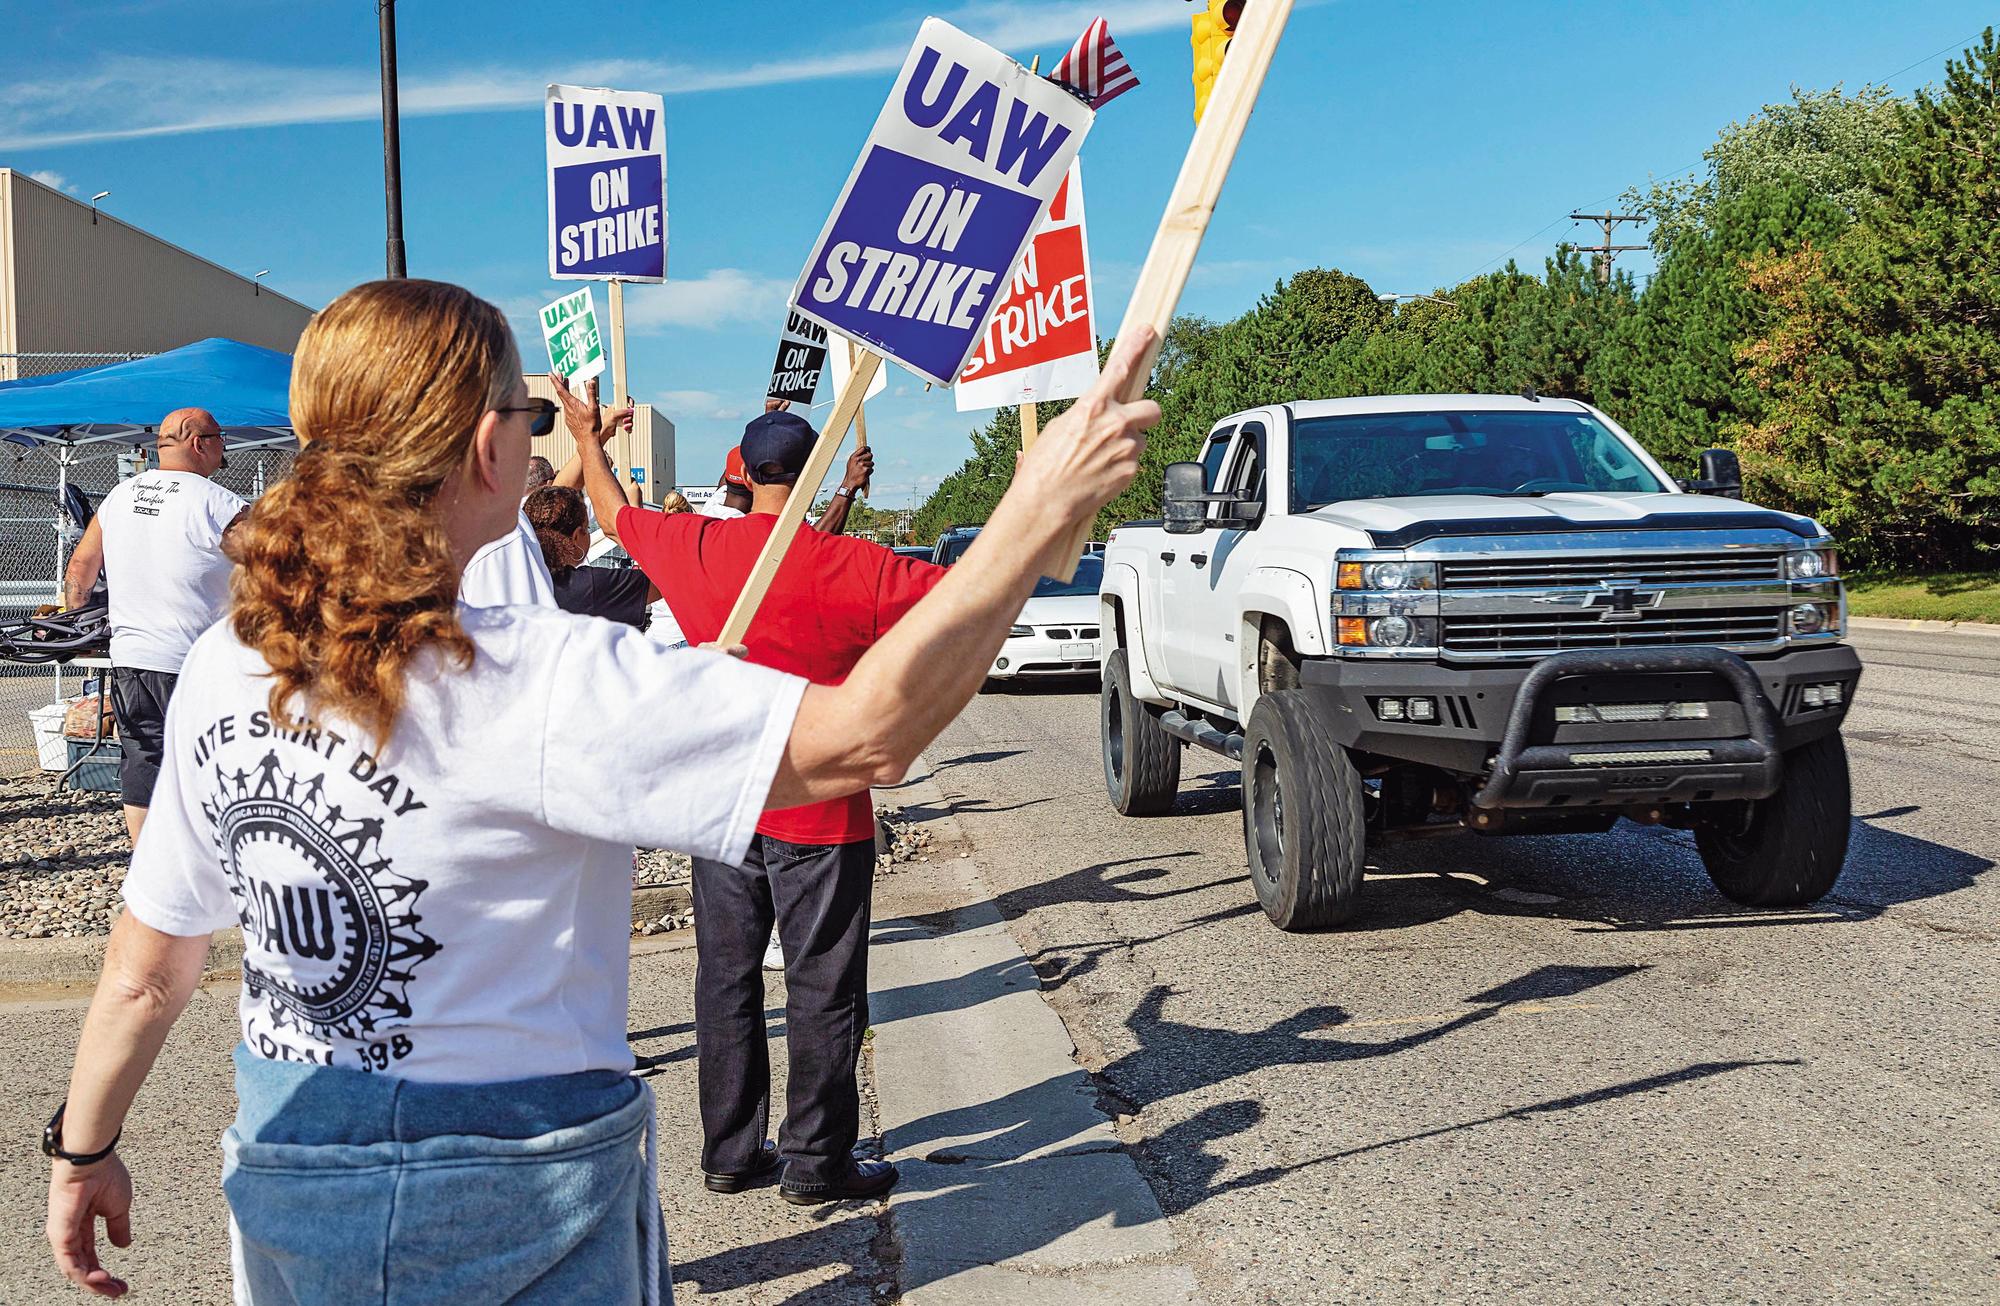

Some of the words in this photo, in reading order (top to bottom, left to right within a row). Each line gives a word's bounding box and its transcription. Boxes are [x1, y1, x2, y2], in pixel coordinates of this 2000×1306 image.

[553, 102, 656, 152] UAW
[903, 45, 1072, 188] UAW
[590, 166, 629, 213] ON
[560, 204, 660, 267] STRIKE
[896, 182, 981, 252] ON
[812, 241, 997, 330] STRIKE
[1001, 241, 1039, 305] N
[544, 292, 587, 329] UAW
[787, 310, 828, 345] UAW
[555, 329, 600, 379] STRIKE
[560, 321, 581, 351] ON
[784, 347, 810, 369] ON
[768, 369, 820, 394] STRIKE
[165, 481, 181, 494] The
[348, 751, 428, 817] DAY
[353, 876, 377, 917] UNION
[356, 1033, 413, 1074] 598
